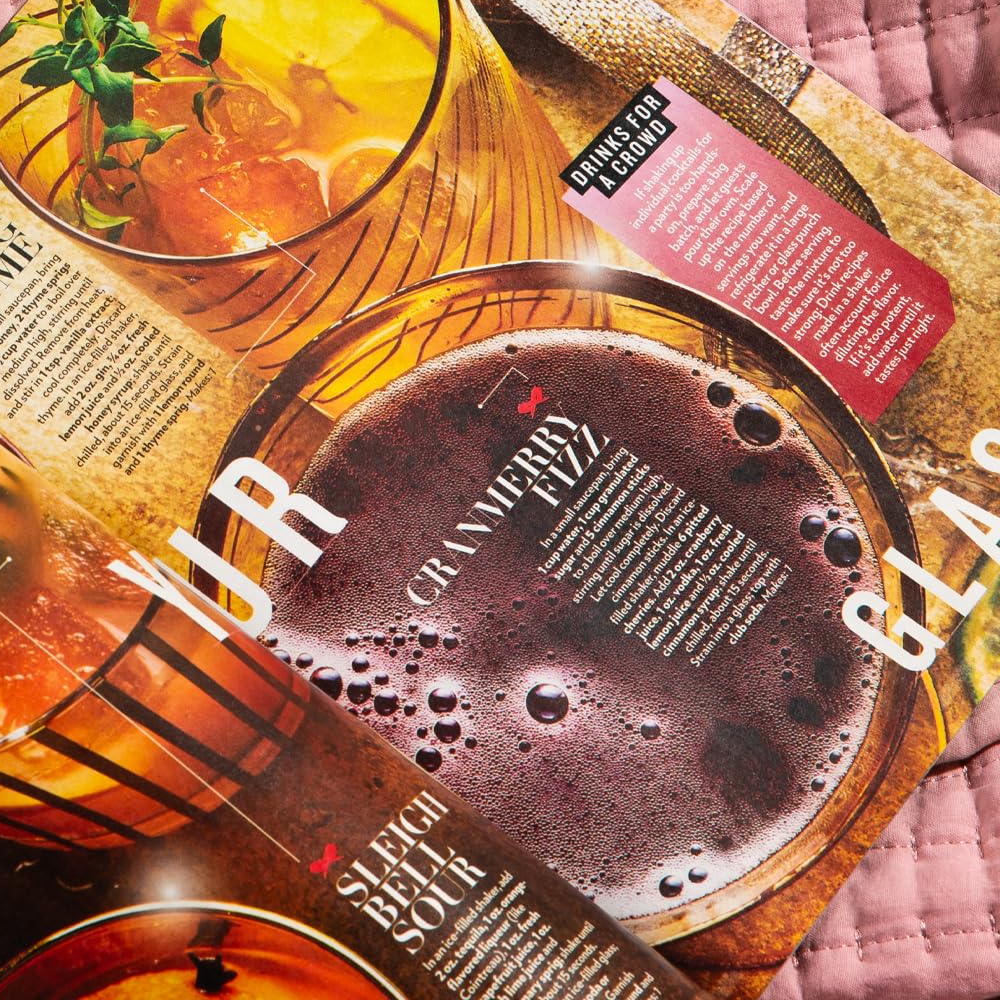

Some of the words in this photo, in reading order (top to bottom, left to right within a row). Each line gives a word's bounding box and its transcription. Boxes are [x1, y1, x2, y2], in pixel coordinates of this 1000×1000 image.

[571, 126, 630, 187] DRINKS
[625, 94, 661, 129] FOR
[599, 174, 616, 191] A
[611, 119, 667, 176] CROWD
[629, 183, 670, 228] individual
[664, 145, 701, 185] cocktails
[695, 131, 712, 147] for
[634, 189, 646, 199] If
[640, 154, 677, 193] shaking
[671, 144, 687, 160] up
[650, 198, 679, 228] party
[670, 191, 682, 201] is
[677, 175, 695, 193] too
[689, 145, 719, 177] hands-
[666, 218, 683, 235] on,
[678, 184, 712, 221] prepare
[708, 161, 729, 180] big
[668, 220, 699, 252] batch,
[691, 203, 711, 223] and
[705, 191, 721, 205] let
[716, 161, 748, 195] guests
[683, 238, 706, 262] pour
[698, 214, 721, 238] their
[718, 195, 738, 217] own.
[733, 169, 758, 195] Scale
[0, 346, 32, 381] medium
[28, 325, 52, 349] high,
[46, 296, 77, 328] stirring
[72, 277, 92, 298] until
[4, 276, 42, 316] saucepan,
[36, 253, 61, 277] bring
[14, 313, 24, 322] 2
[20, 286, 50, 316] thyme
[44, 261, 72, 290] sprigs
[1, 358, 40, 400] dissolved.
[36, 326, 68, 359] Remove
[64, 306, 85, 327] from
[81, 285, 104, 308] heat,
[407, 401, 579, 606] CRANMERRY
[530, 423, 611, 508] FIZZ
[540, 536, 552, 547] In
[553, 508, 575, 532] small
[573, 470, 611, 512] saucepan,
[604, 446, 629, 472] bring
[544, 551, 562, 569] cup
[555, 522, 583, 552] water,
[584, 502, 602, 521] cup
[595, 454, 640, 504] granulated
[554, 554, 578, 581] sugar
[571, 536, 589, 555] and
[585, 530, 595, 538] 5
[590, 488, 629, 532] cinnamon
[624, 462, 649, 490] sticks
[571, 566, 584, 578] to
[584, 545, 601, 562] boil
[599, 528, 616, 547] over
[612, 492, 644, 528] medium
[640, 471, 664, 495] high,
[335, 789, 449, 908] SLEIGH
[359, 838, 456, 932] BELL
[392, 853, 487, 955] SOUR
[422, 957, 436, 970] In
[433, 947, 447, 960] an
[441, 909, 479, 948] ice-filled
[473, 884, 503, 913] shaker,
[495, 871, 512, 887] add
[434, 970, 446, 981] 2
[443, 958, 458, 974] oz.
[453, 922, 490, 961] tequila,
[482, 916, 493, 925] 1
[490, 906, 503, 919] oz.
[500, 880, 529, 909] orange-
